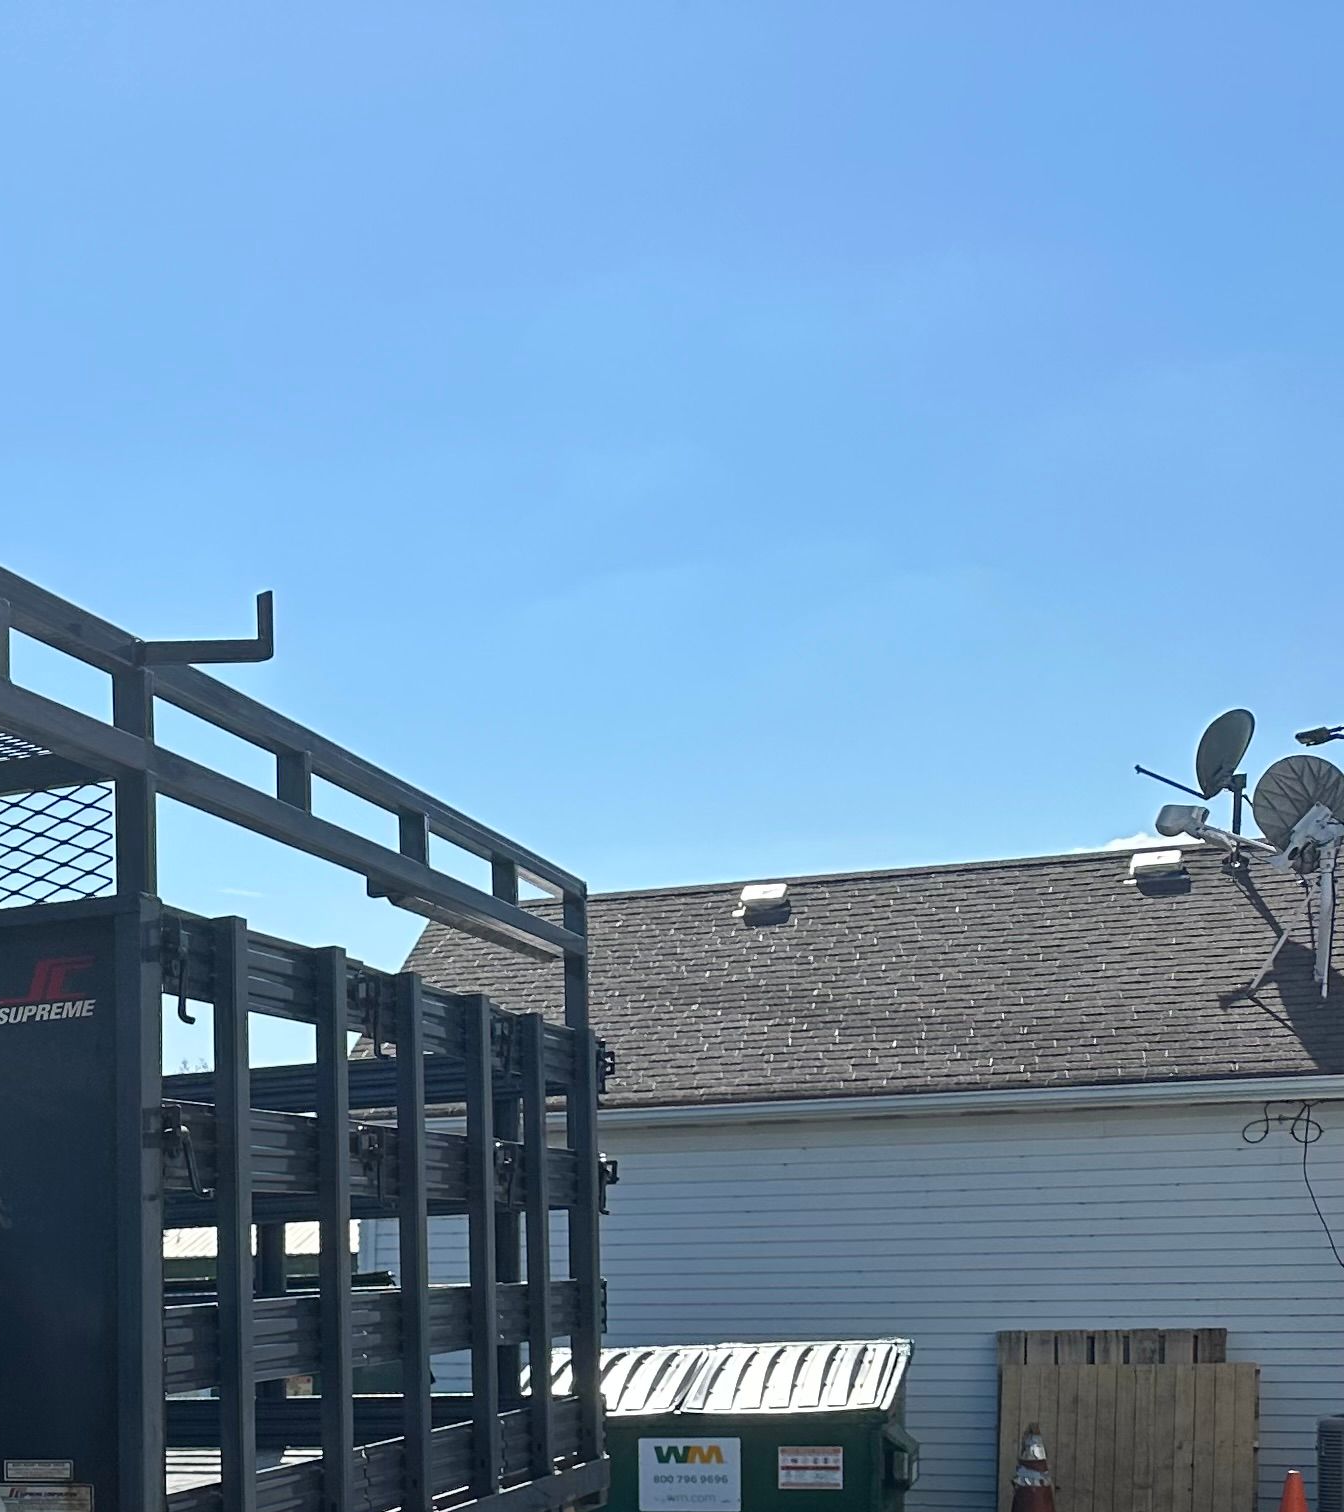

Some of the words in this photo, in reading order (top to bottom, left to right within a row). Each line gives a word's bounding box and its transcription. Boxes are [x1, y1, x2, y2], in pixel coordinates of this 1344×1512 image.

[653, 1445, 724, 1464] WM
[653, 1474, 674, 1484] 800
[676, 1474, 698, 1484] 796
